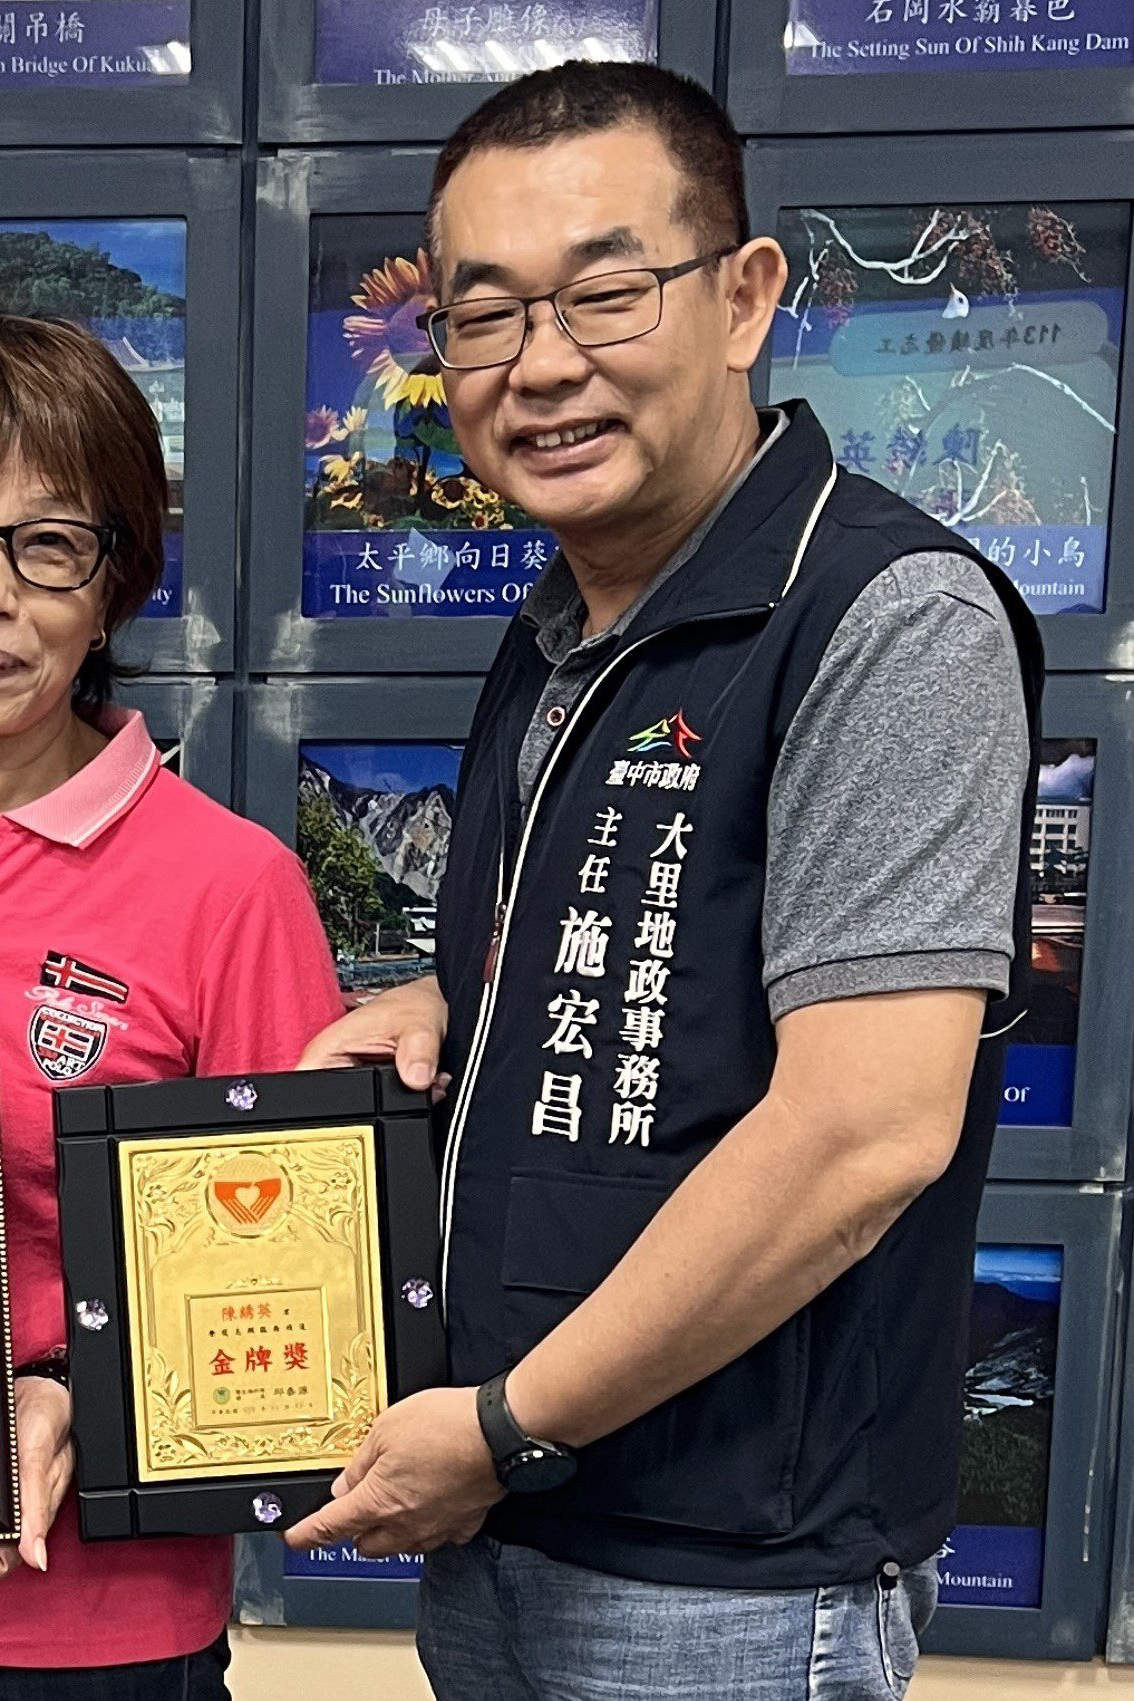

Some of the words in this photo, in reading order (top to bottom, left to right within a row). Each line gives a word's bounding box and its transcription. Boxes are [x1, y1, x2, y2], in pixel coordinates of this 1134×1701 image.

[811, 41, 842, 59] The
[848, 40, 910, 60] Setting
[916, 37, 949, 55] Sun
[955, 36, 982, 54] Of
[985, 35, 1025, 54] Shih
[1031, 34, 1080, 55] Kang
[1085, 33, 1129, 51] Dam
[11, 56, 67, 78] Bridge
[72, 55, 97, 74] Of
[374, 69, 406, 85] The
[330, 584, 370, 604] The
[377, 583, 495, 604] Sunflowers
[502, 583, 534, 603] Of
[1013, 579, 1085, 596] ountain
[577, 806, 623, 894] 主任
[608, 812, 694, 1148] 大里地政事務所
[531, 906, 613, 1142] 施宏昌
[209, 1341, 309, 1376] 金牌獎
[936, 1571, 1013, 1589] Mountain
